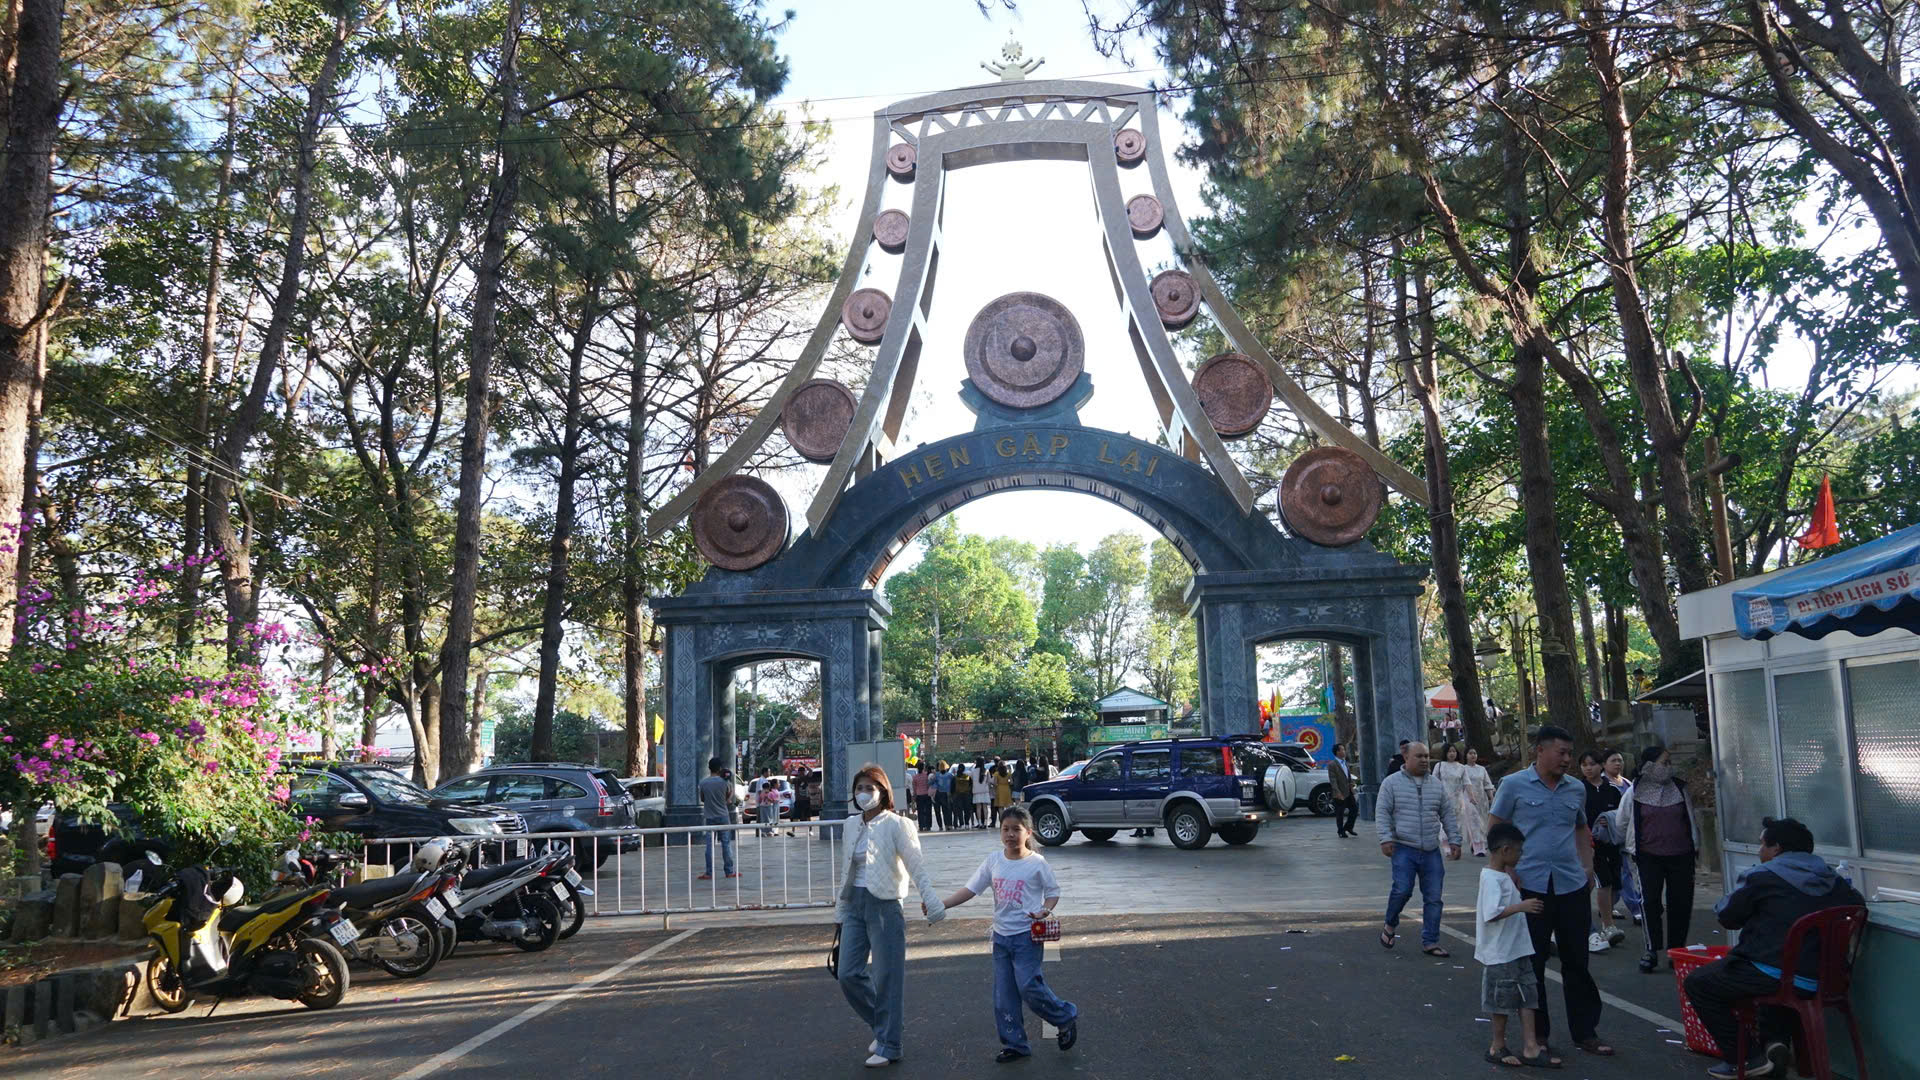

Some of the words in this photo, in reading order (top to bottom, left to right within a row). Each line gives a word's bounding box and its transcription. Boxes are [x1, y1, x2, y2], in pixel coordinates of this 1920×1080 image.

[899, 445, 970, 488] HẸN
[1096, 440, 1160, 477] LẠI
[1812, 589, 1845, 609] TÍCH
[1847, 581, 1884, 602] LỊCH
[1886, 570, 1911, 591] SỬ
